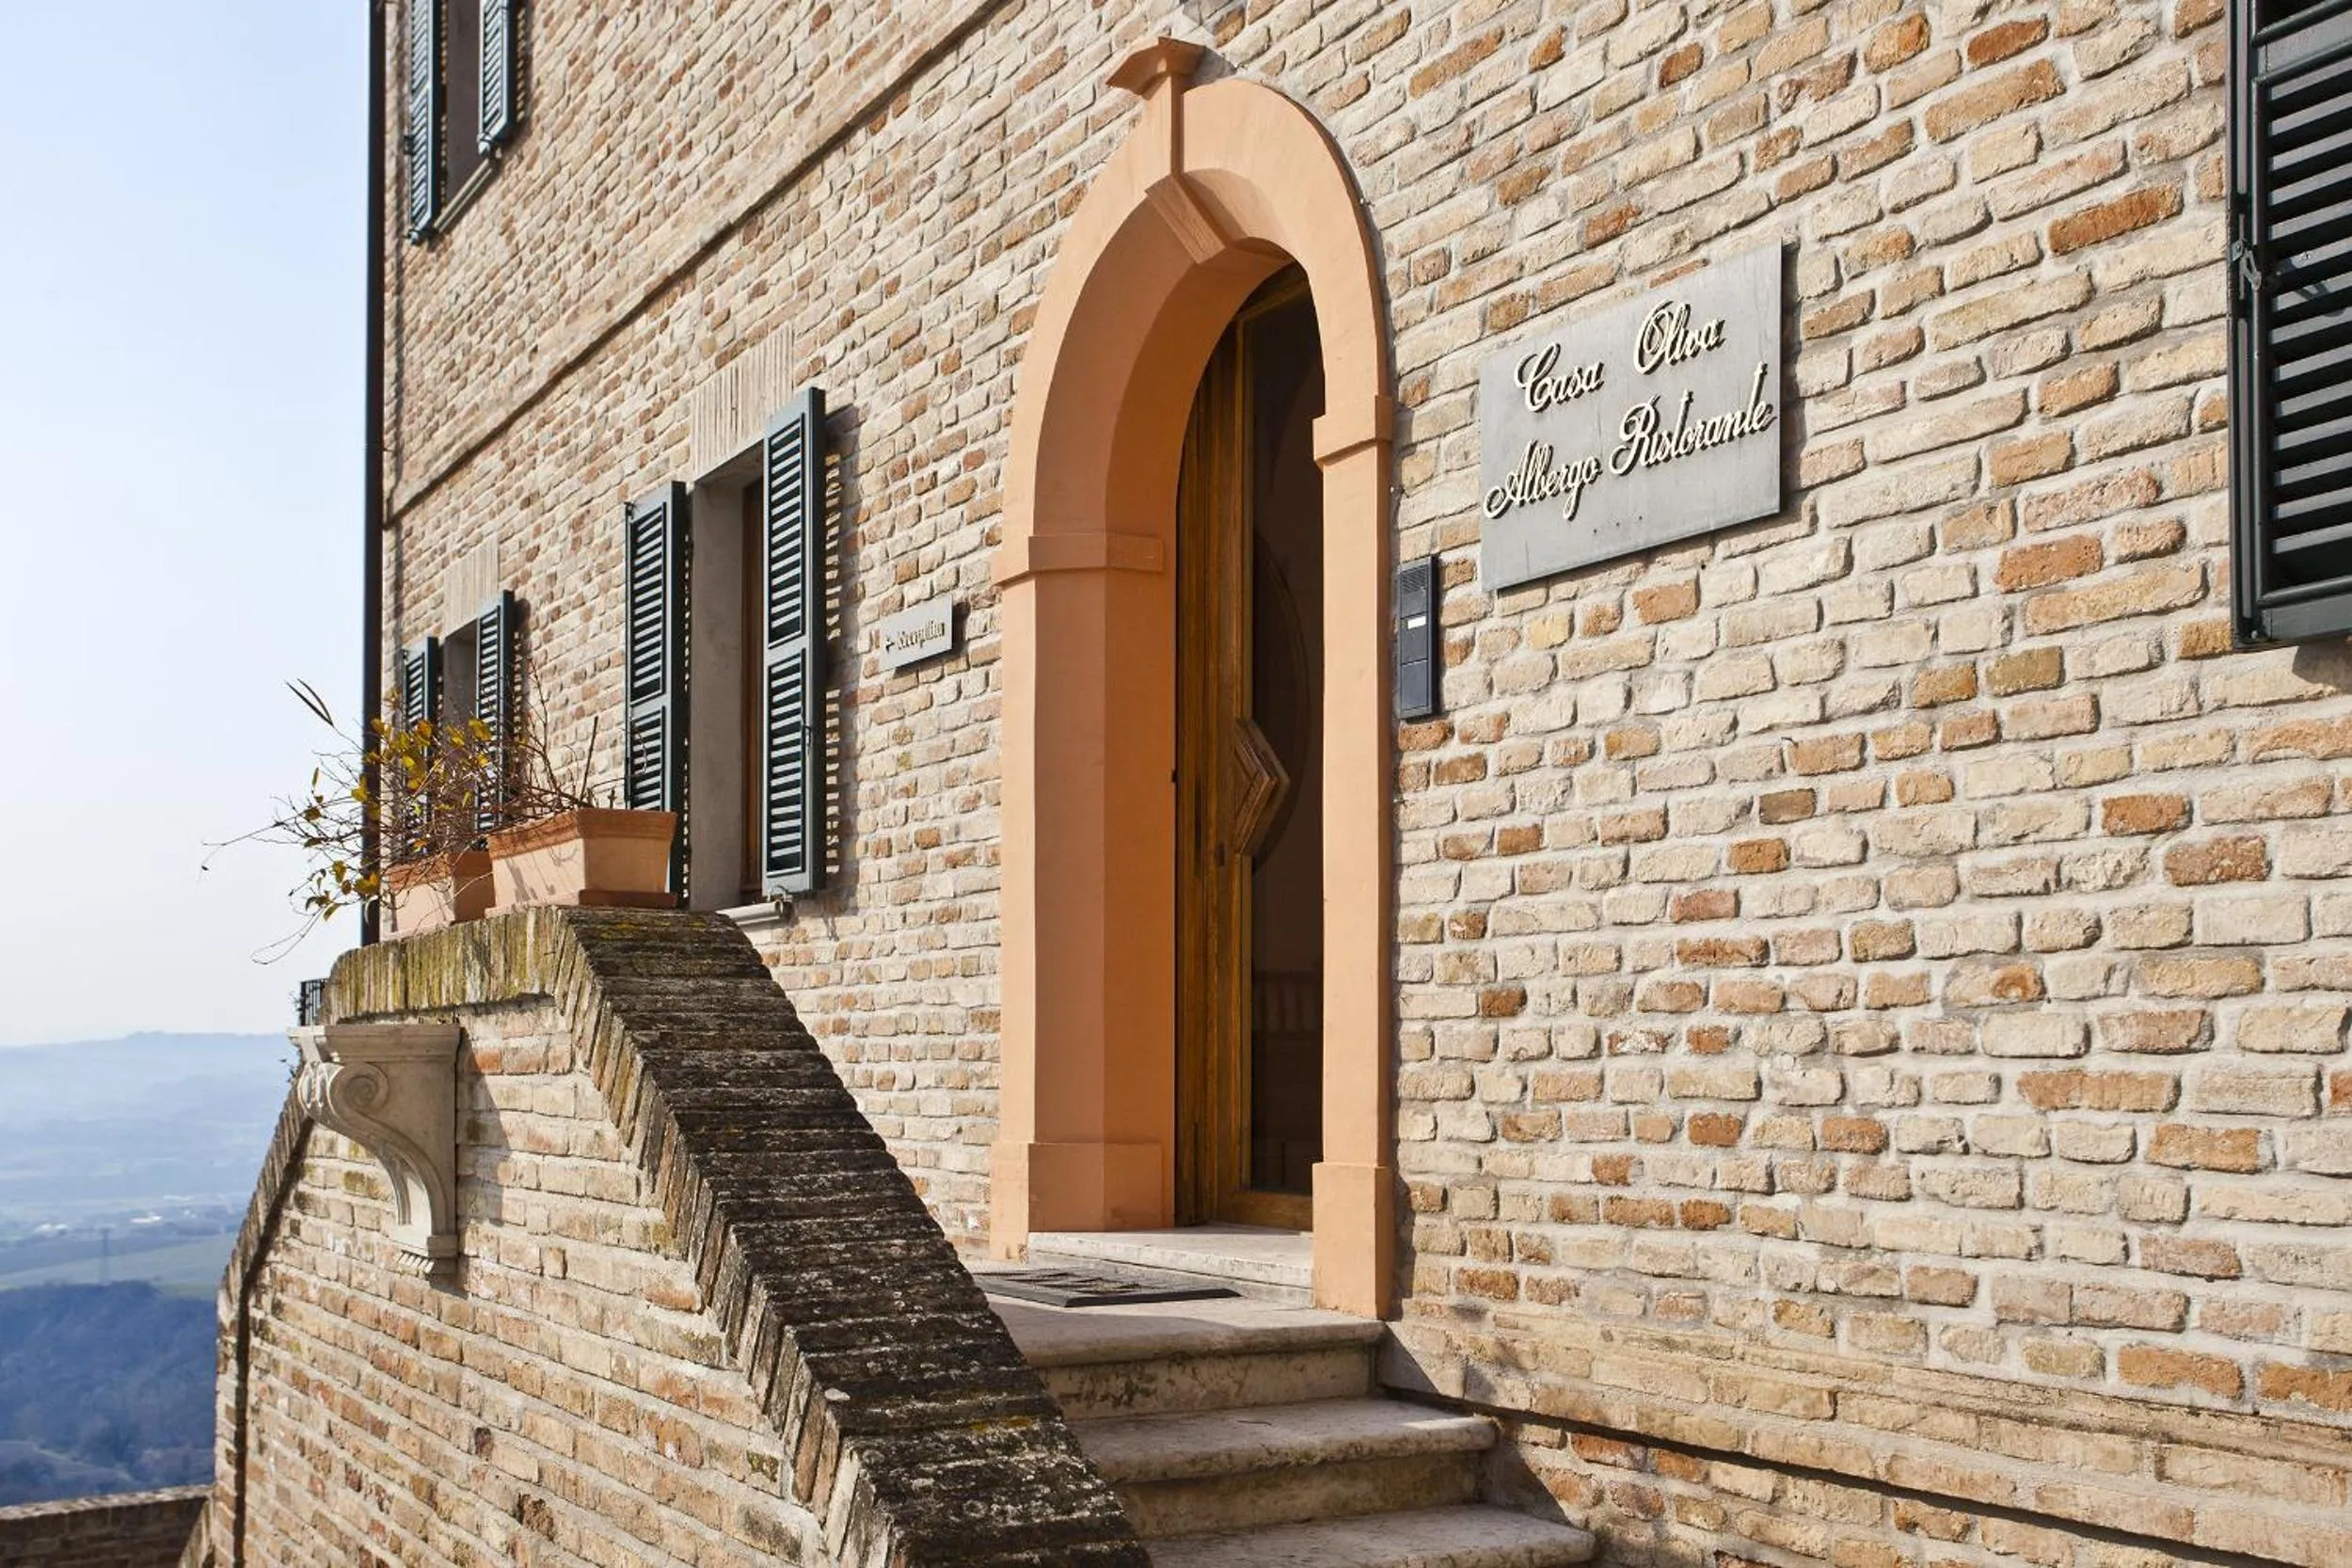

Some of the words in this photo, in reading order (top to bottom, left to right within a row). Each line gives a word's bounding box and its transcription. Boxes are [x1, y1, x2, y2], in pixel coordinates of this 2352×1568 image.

[1515, 341, 1603, 411] Casa
[1634, 300, 1724, 373] Oliva
[1484, 440, 1602, 519] Albergo
[1610, 362, 1776, 474] Ristorante
